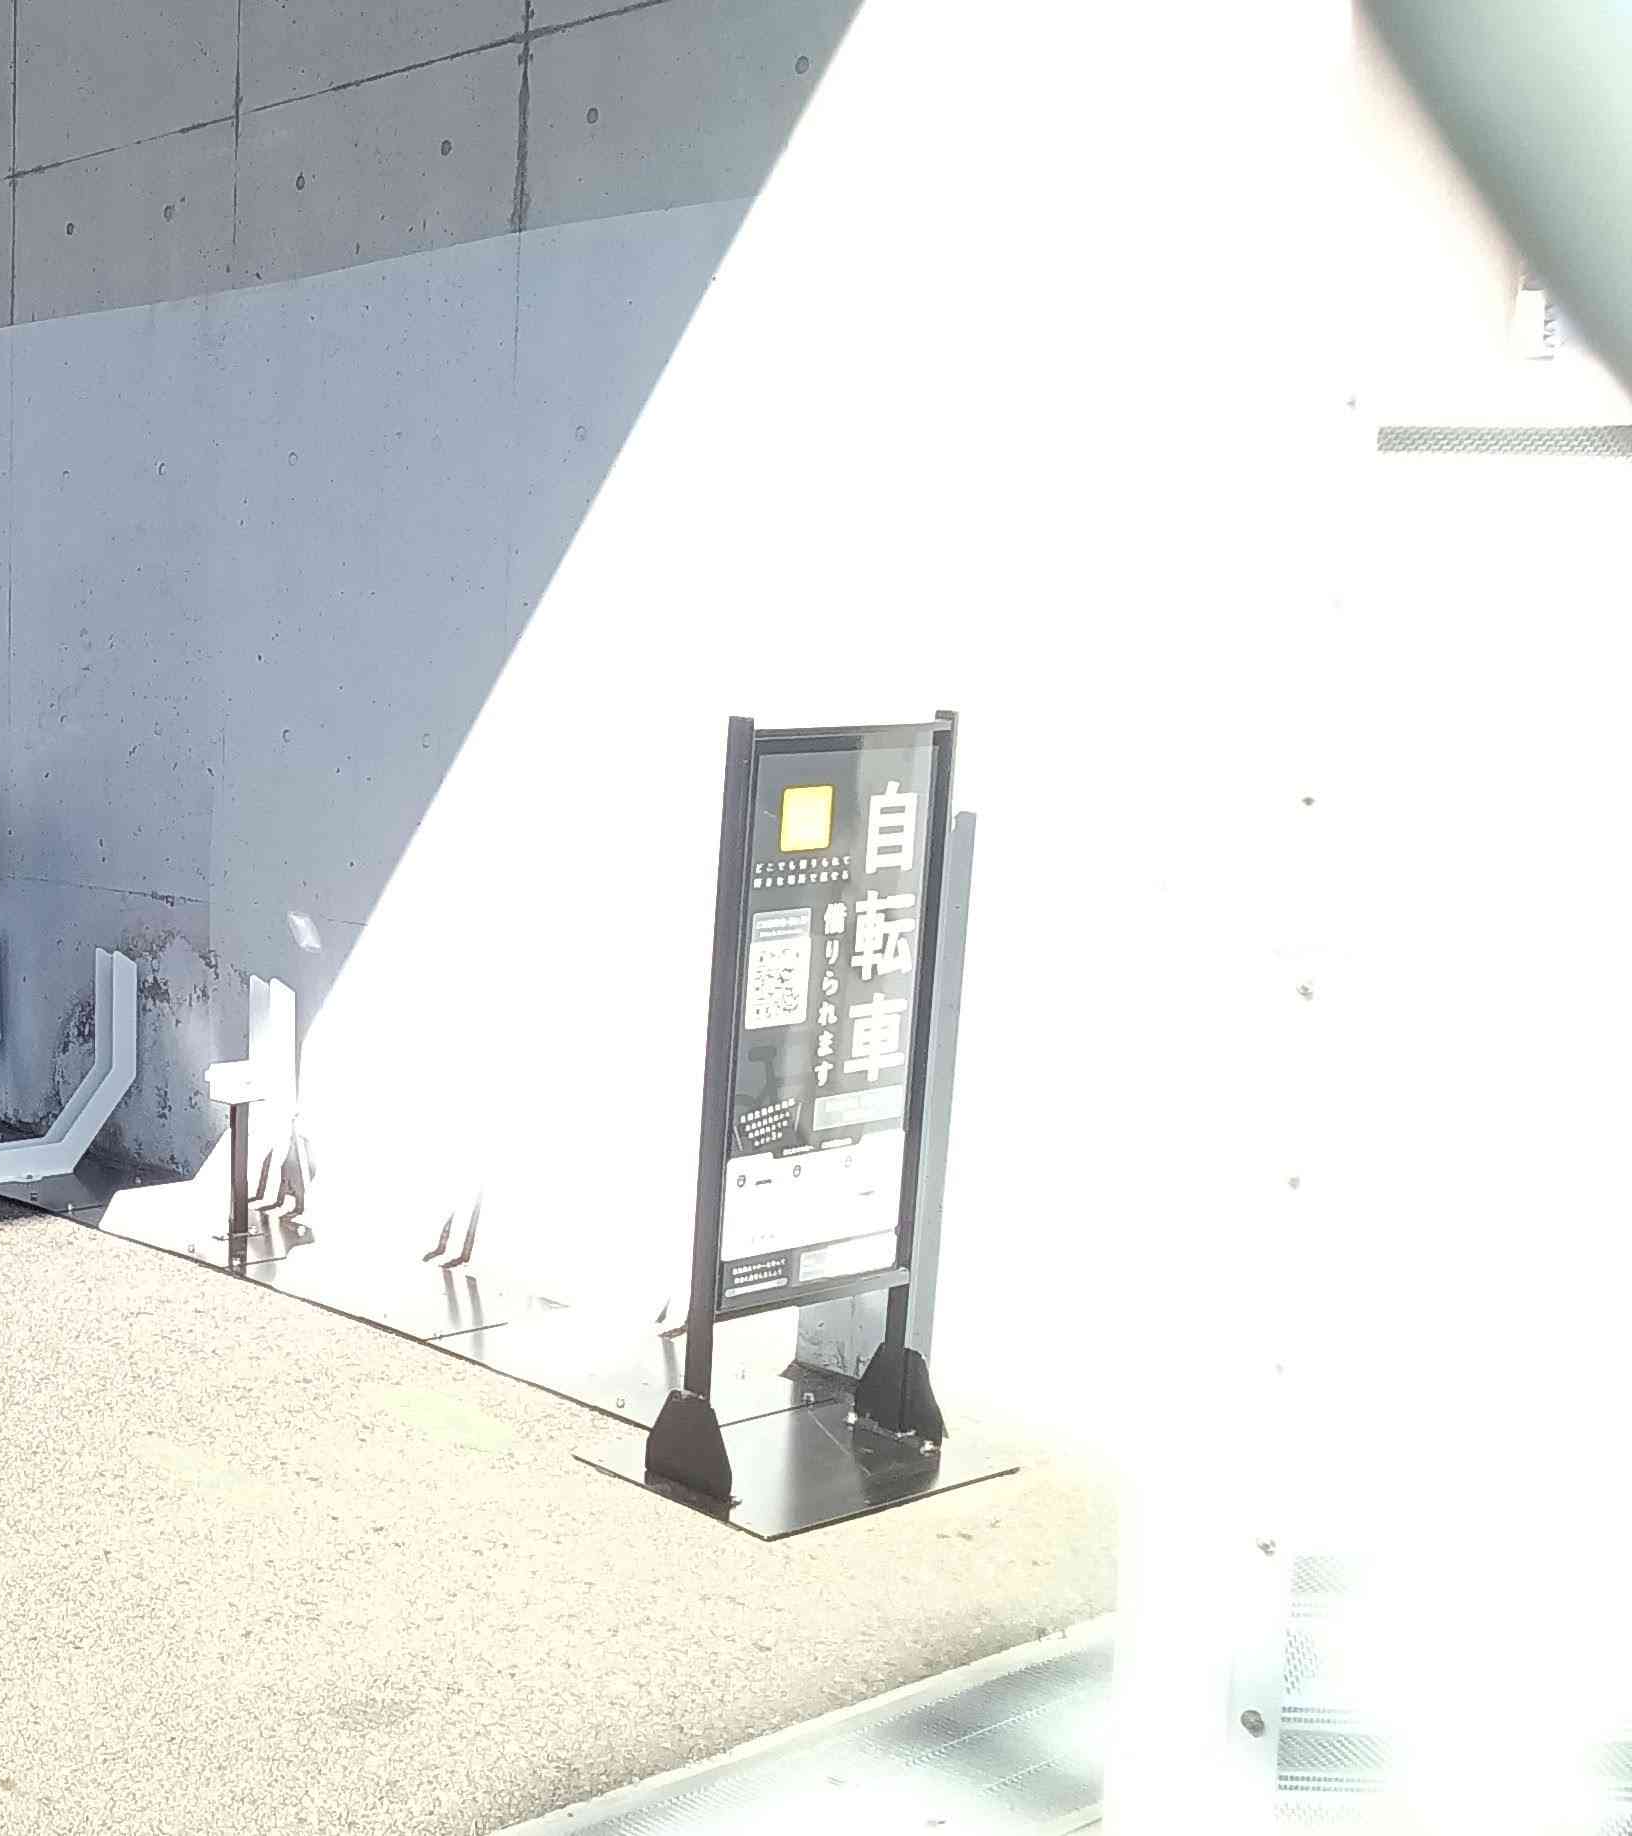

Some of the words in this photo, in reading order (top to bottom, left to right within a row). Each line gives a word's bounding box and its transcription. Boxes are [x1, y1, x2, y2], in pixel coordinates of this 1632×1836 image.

[813, 902, 848, 1087] 借りられます
[843, 781, 918, 1082] 自転車
